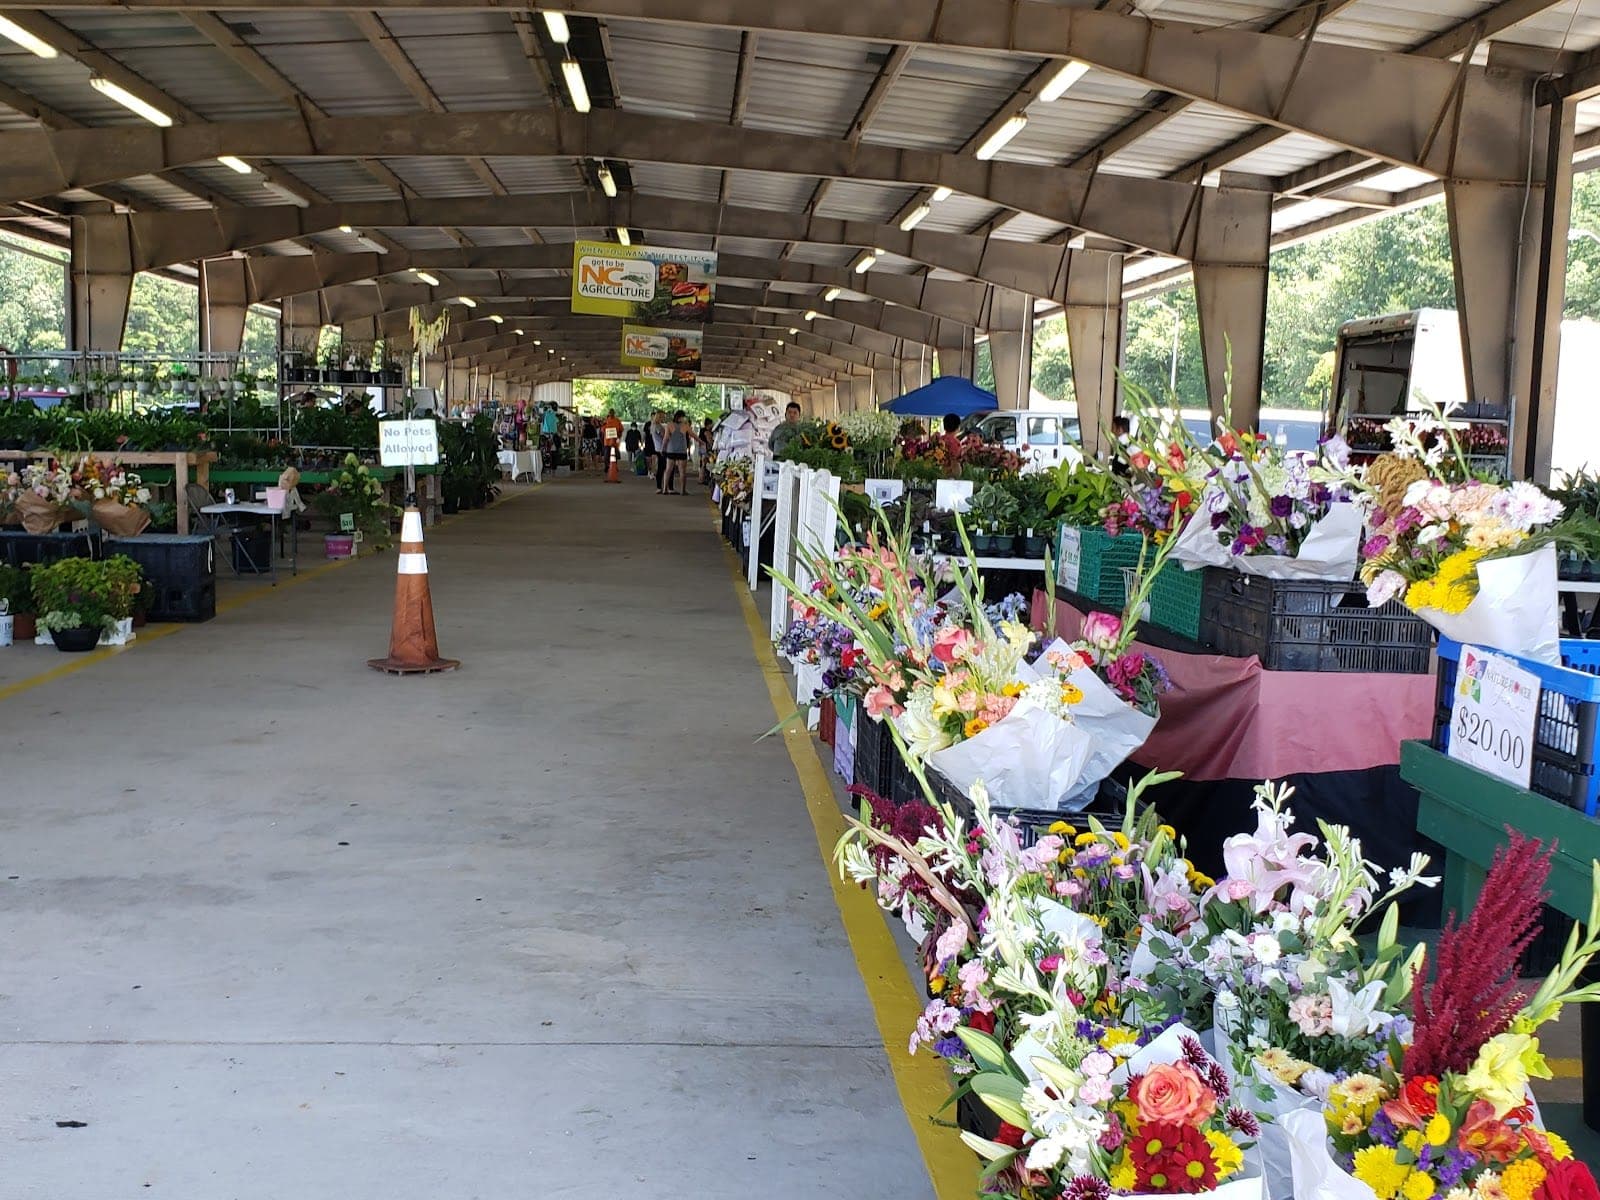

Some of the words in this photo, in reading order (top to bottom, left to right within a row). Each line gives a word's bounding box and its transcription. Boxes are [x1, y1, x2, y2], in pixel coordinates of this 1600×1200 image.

[592, 259, 605, 267] got
[581, 264, 624, 287] NC
[581, 284, 651, 299] AGRICULTURE
[626, 338, 650, 351] NC
[384, 428, 400, 437] No
[404, 427, 431, 436] Pets
[384, 443, 433, 454] Allowed
[1457, 705, 1524, 769] $20.00
